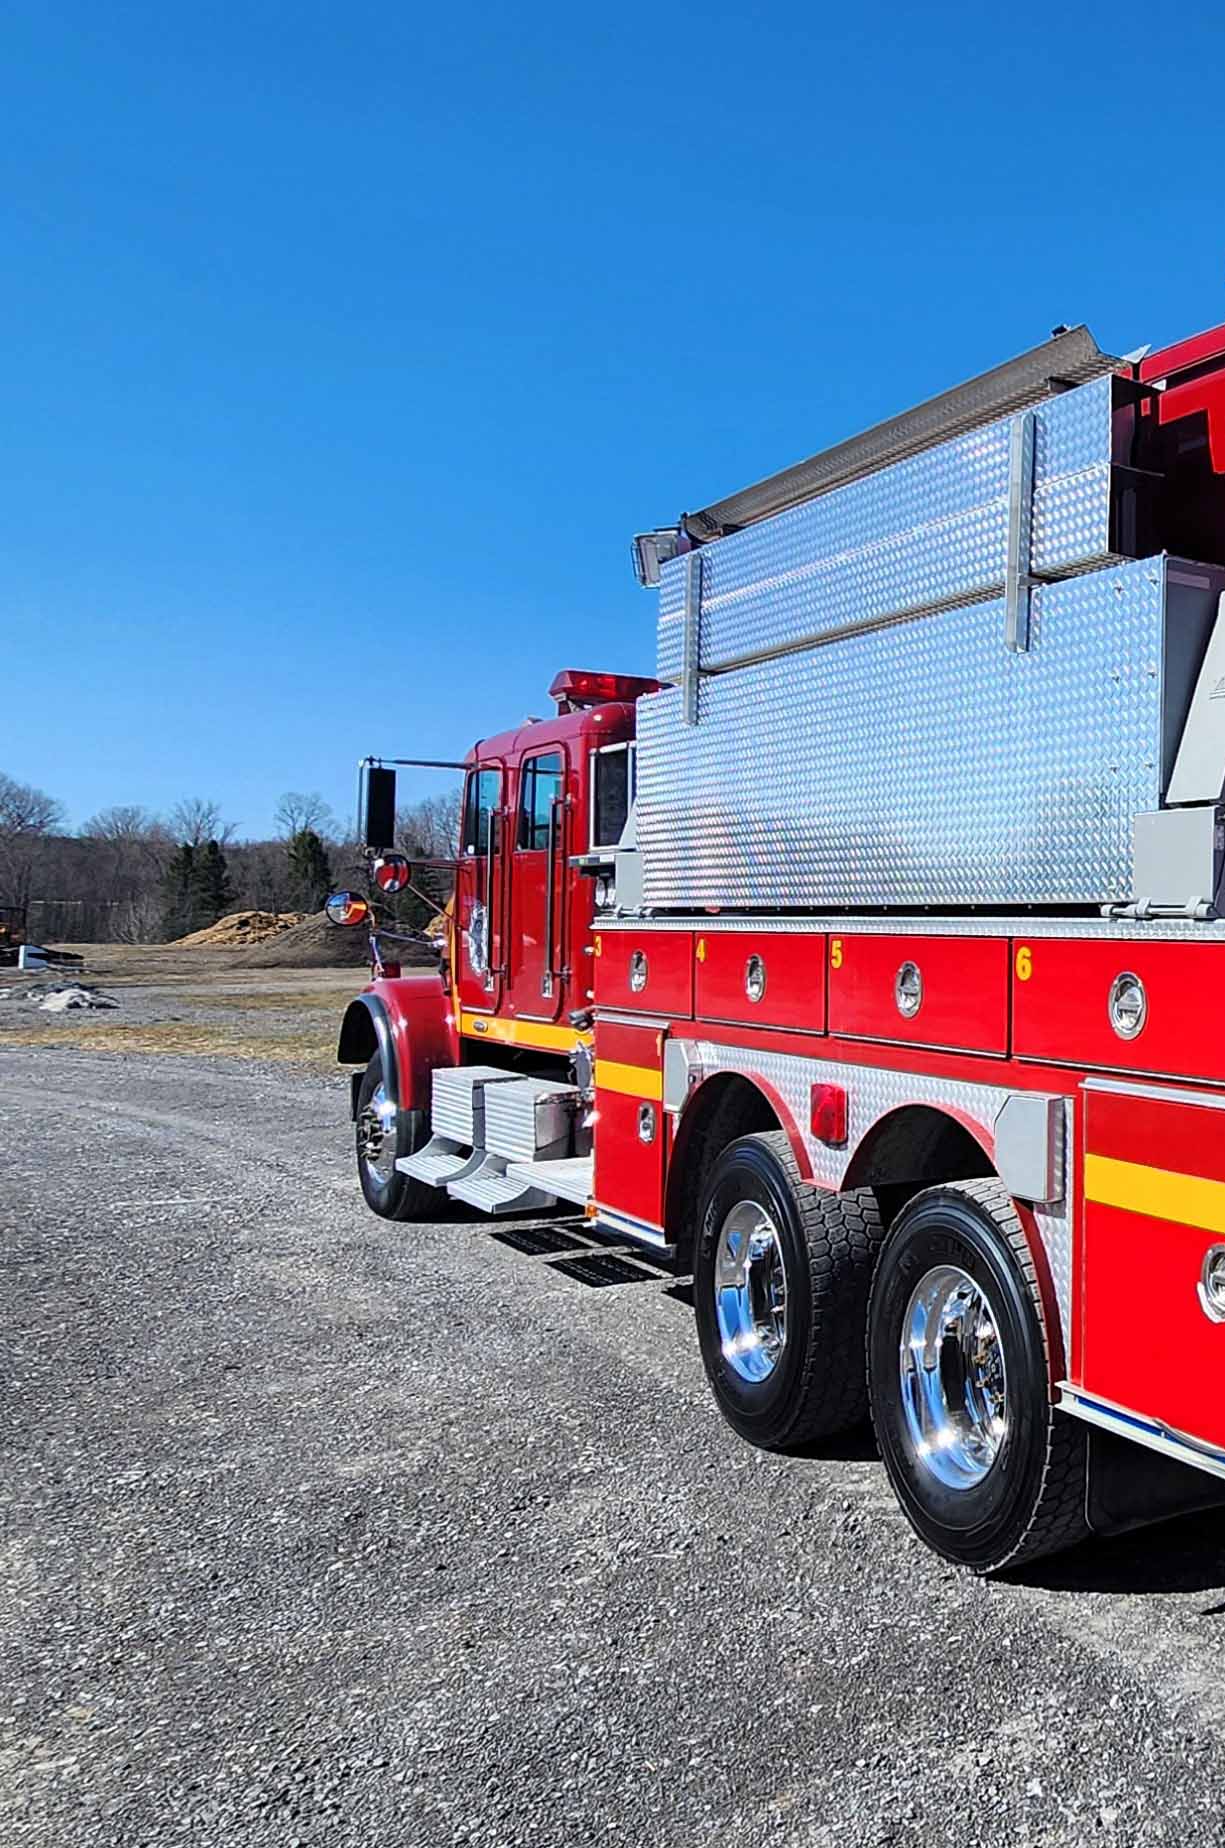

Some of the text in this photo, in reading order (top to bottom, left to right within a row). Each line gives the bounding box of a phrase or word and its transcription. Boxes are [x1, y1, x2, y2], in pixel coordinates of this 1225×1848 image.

[594, 935, 602, 957] 3
[695, 938, 706, 962] 4
[831, 940, 843, 969] 5
[1015, 945, 1033, 981] 6
